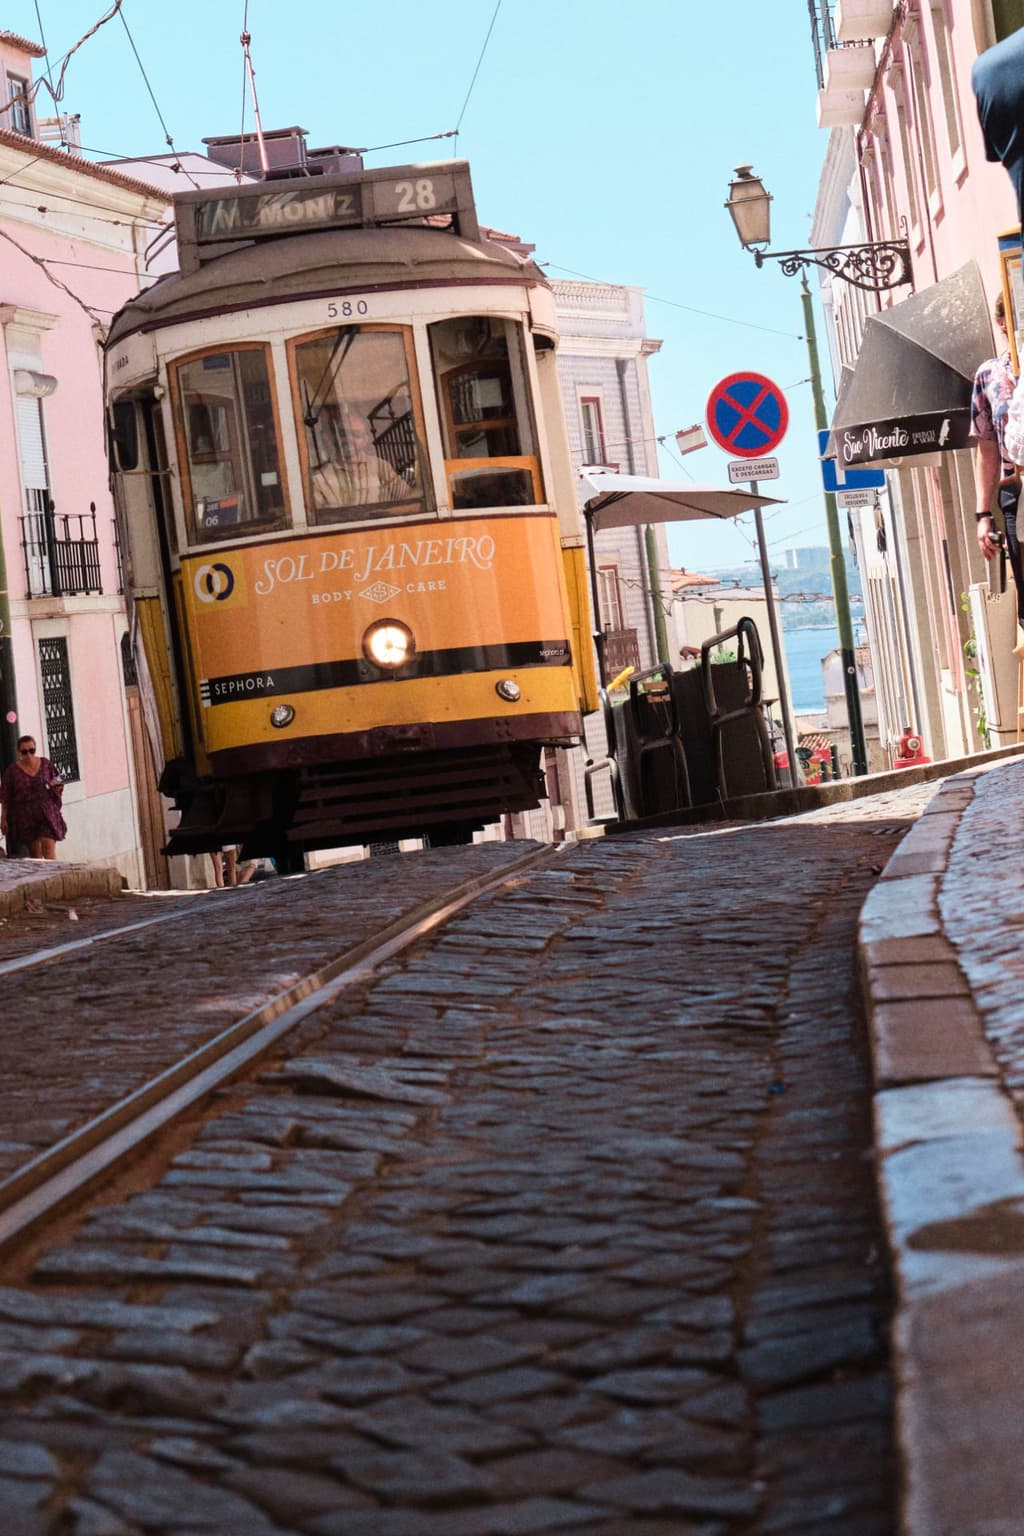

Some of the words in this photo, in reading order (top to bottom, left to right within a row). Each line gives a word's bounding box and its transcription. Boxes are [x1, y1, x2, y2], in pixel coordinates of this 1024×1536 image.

[394, 178, 437, 213] 28
[258, 193, 355, 226] MONIZ
[327, 299, 369, 319] 580
[843, 430, 863, 462] São
[862, 426, 910, 457] Vicente
[731, 465, 753, 473] EXCETO
[753, 463, 777, 471] CARGAS
[740, 469, 774, 477] DESCARGAS
[254, 555, 315, 596] SOL
[319, 548, 356, 573] DE
[353, 535, 496, 582] JANEIRO
[311, 589, 353, 605] BODY
[406, 579, 448, 594] CARE
[214, 675, 275, 696] SEPHORA
